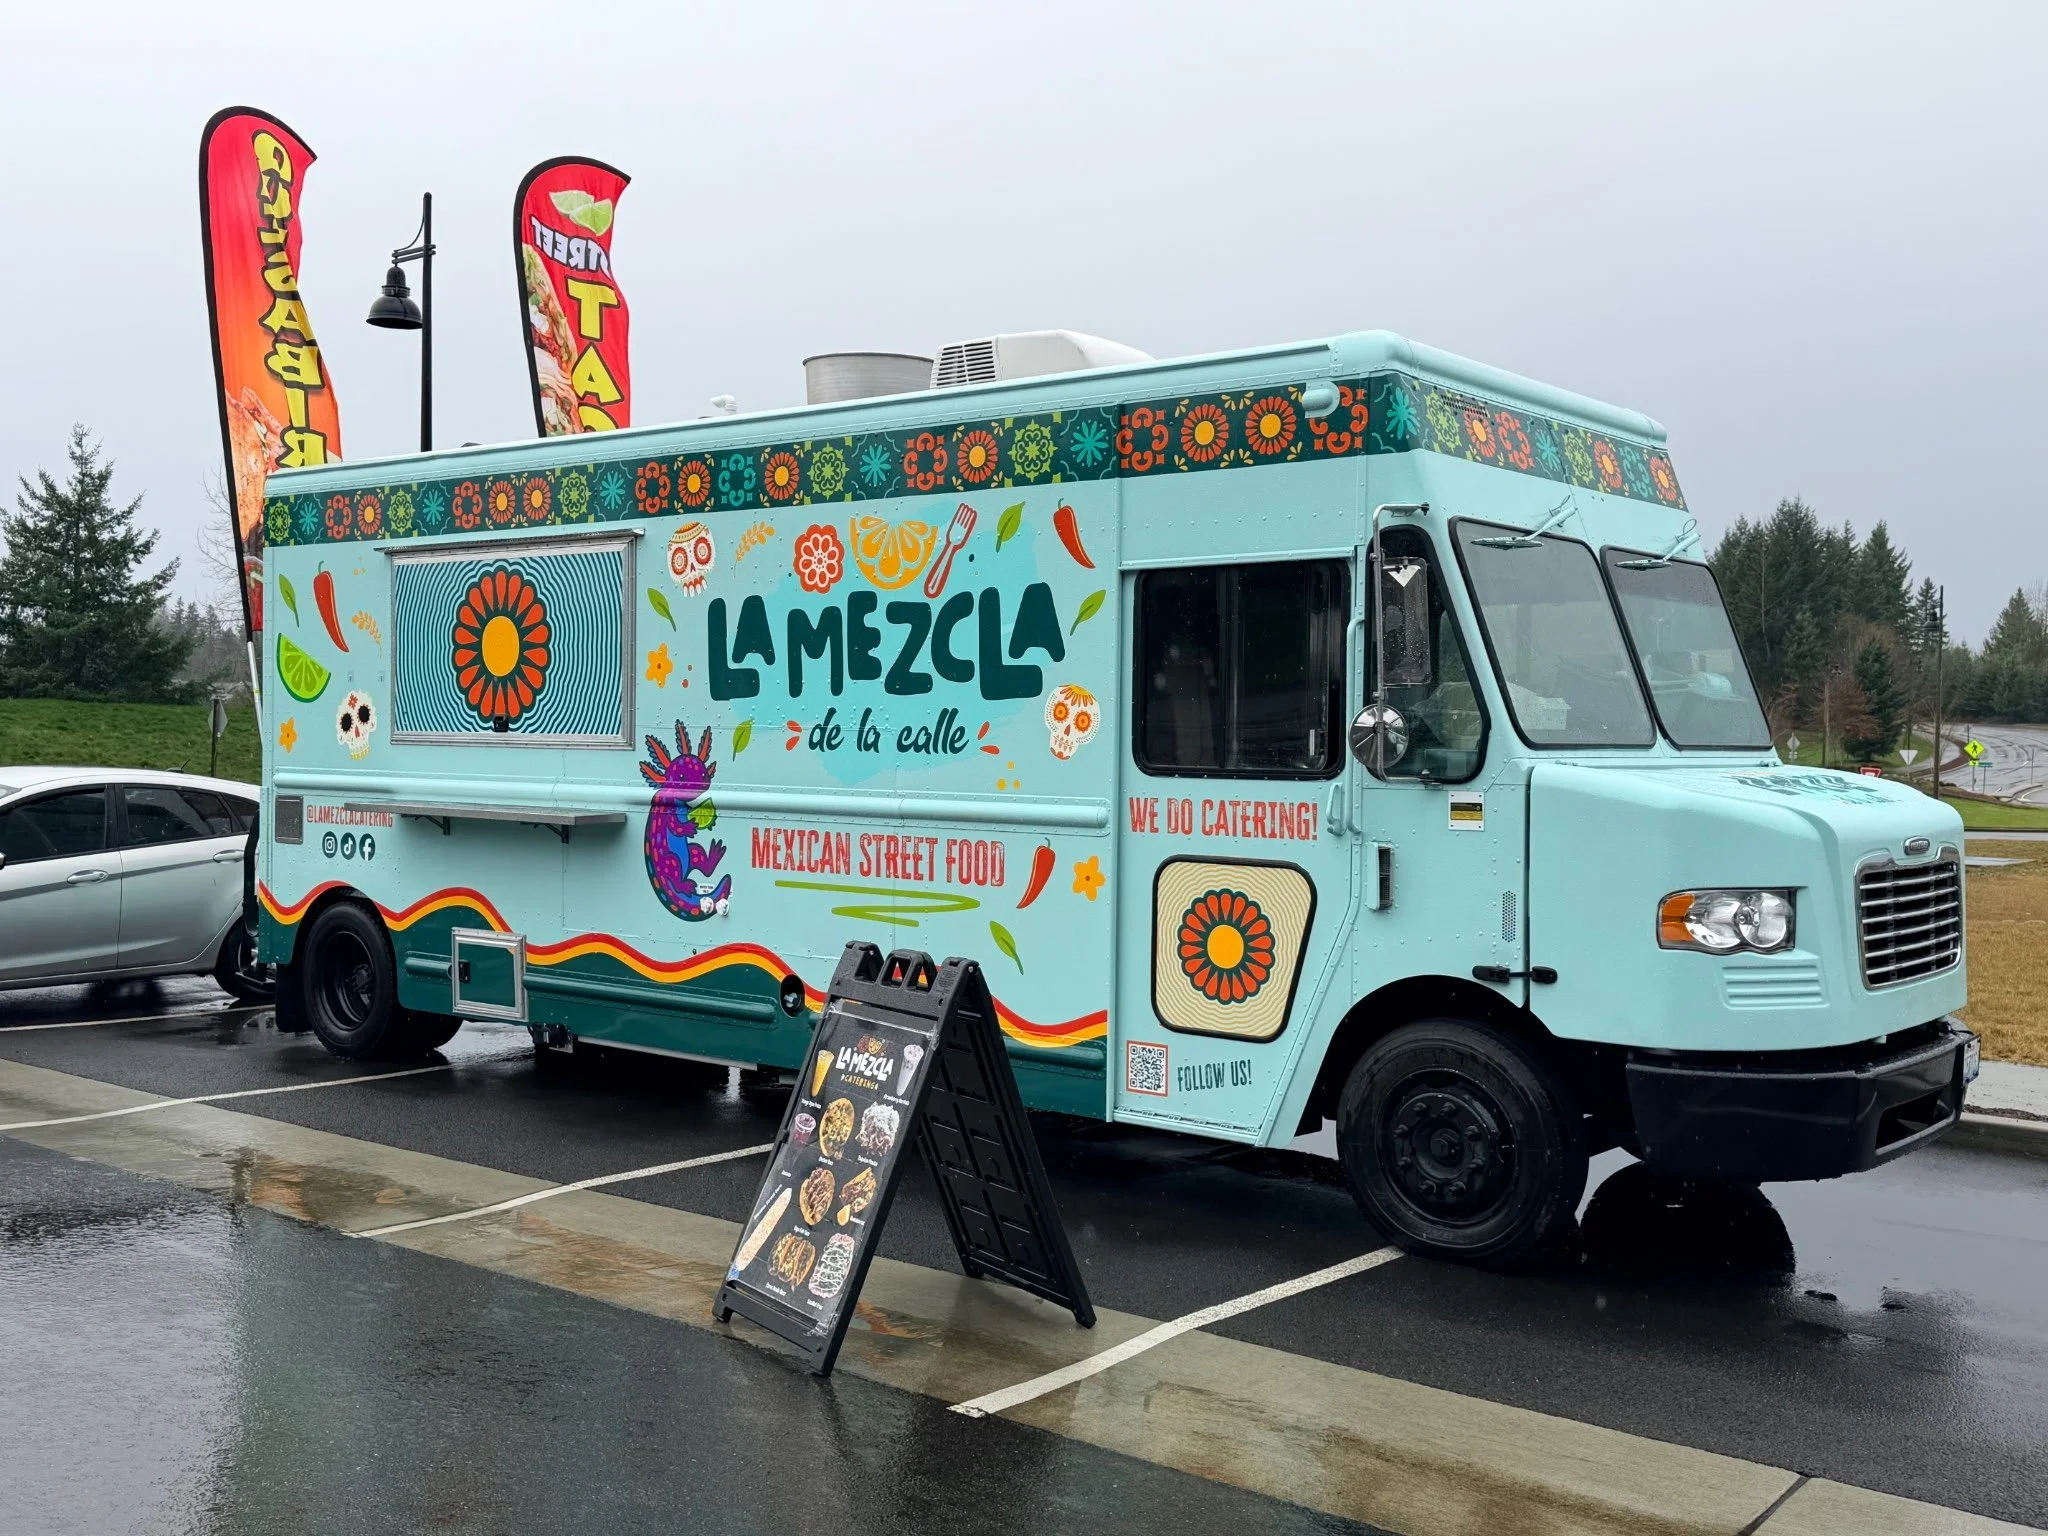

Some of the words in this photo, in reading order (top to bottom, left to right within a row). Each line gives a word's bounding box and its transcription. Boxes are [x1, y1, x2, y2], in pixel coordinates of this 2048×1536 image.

[707, 595, 776, 701] LA
[787, 582, 1066, 701] MEZCLA
[808, 707, 845, 753] de
[857, 707, 880, 754] la
[896, 708, 970, 754] calle
[1129, 797, 1159, 833] WE
[1167, 798, 1193, 836] DO
[1201, 799, 1319, 840] CATERING!
[751, 828, 851, 876] MEXICAN
[859, 832, 939, 882] STREET
[945, 838, 1006, 888] FOOD
[835, 1046, 852, 1070] LA
[848, 1051, 894, 1081] MEZCLA
[1177, 1062, 1225, 1093] FOLLOW
[1230, 1059, 1252, 1087] US!
